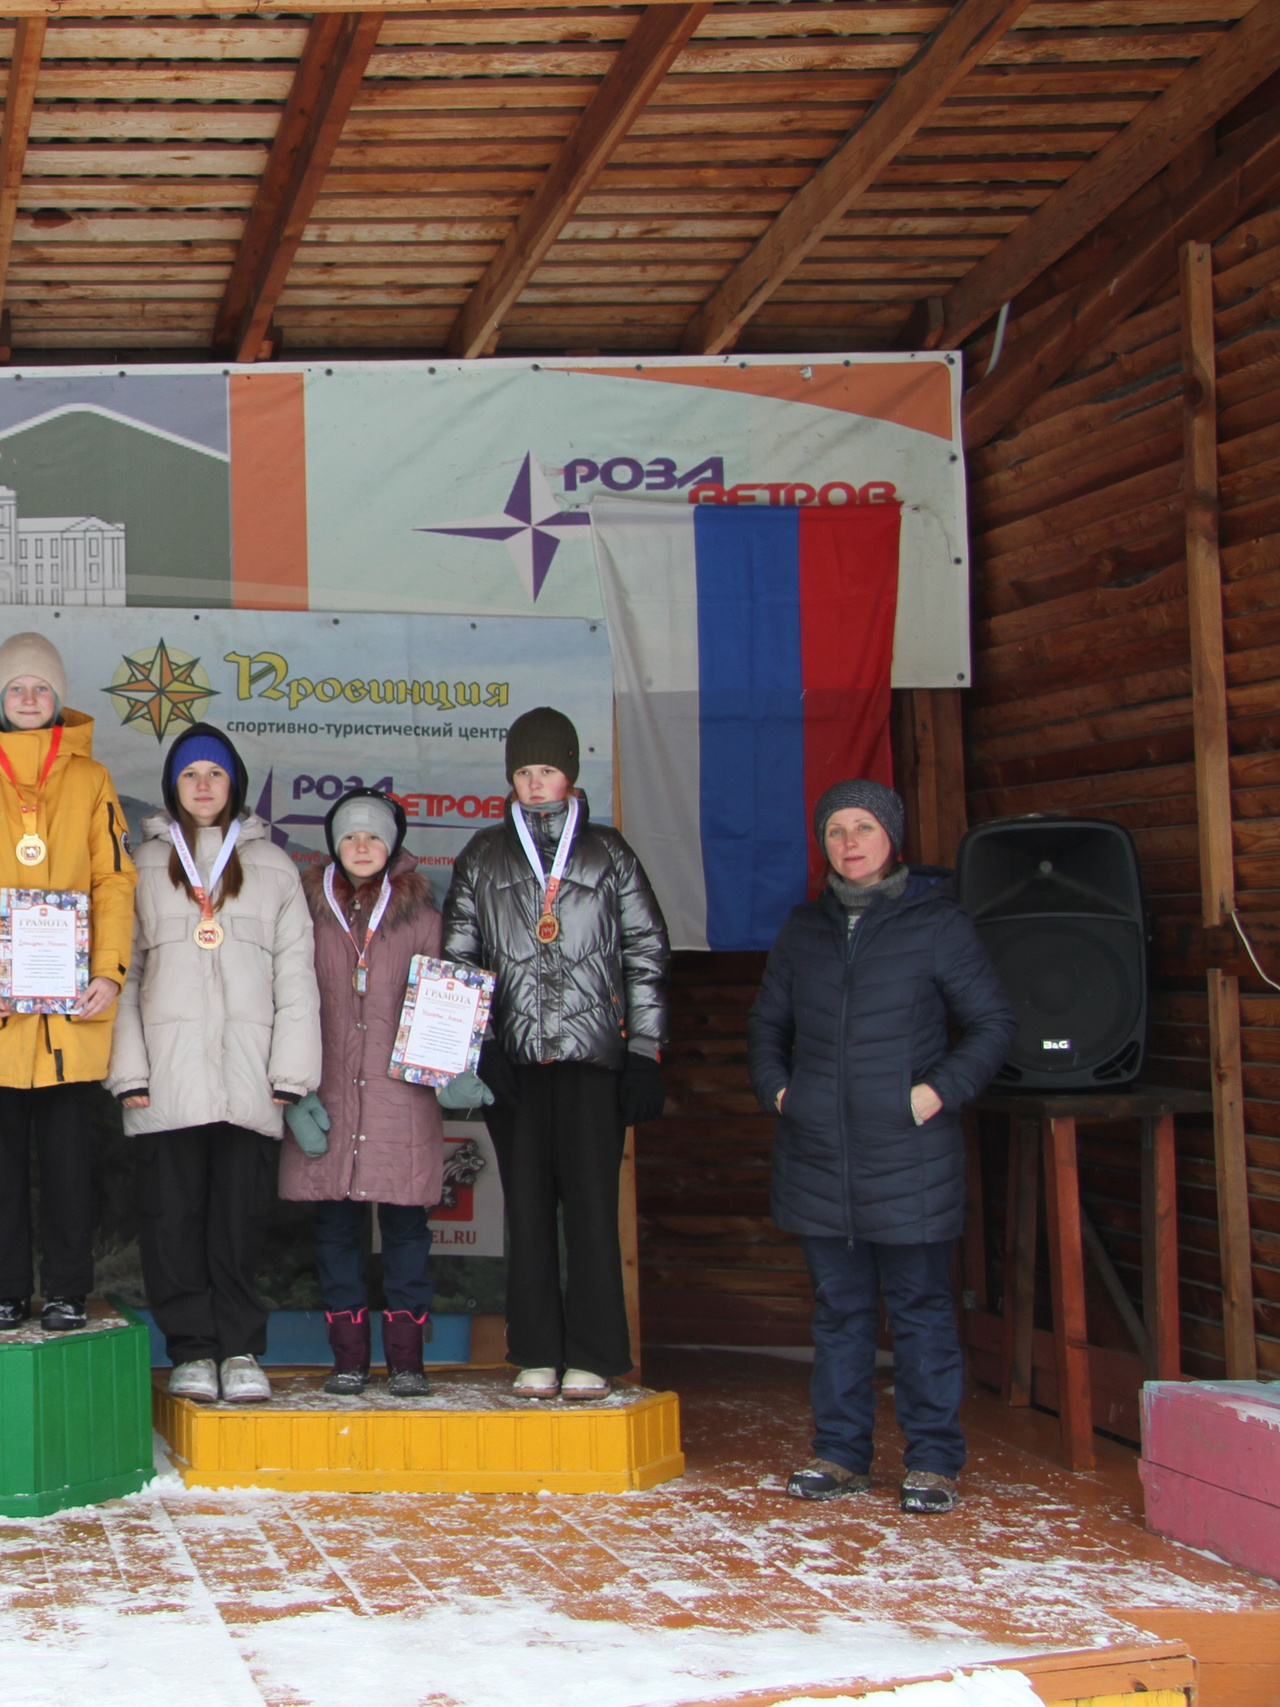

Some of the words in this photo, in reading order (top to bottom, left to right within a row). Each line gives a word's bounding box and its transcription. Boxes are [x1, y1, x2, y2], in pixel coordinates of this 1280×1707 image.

[563, 457, 724, 491] РОЗА
[223, 651, 509, 711] Провинция
[226, 720, 453, 738] спортивно-туристический
[457, 723, 509, 742] центр
[388, 793, 506, 819] ЕТРОВ
[291, 849, 321, 865] Клуб
[19, 919, 69, 928] ГРАМОТА
[425, 988, 472, 1005] ГРАМОТА
[1042, 1040, 1069, 1050] B&G
[431, 1229, 477, 1245] EL.RU
